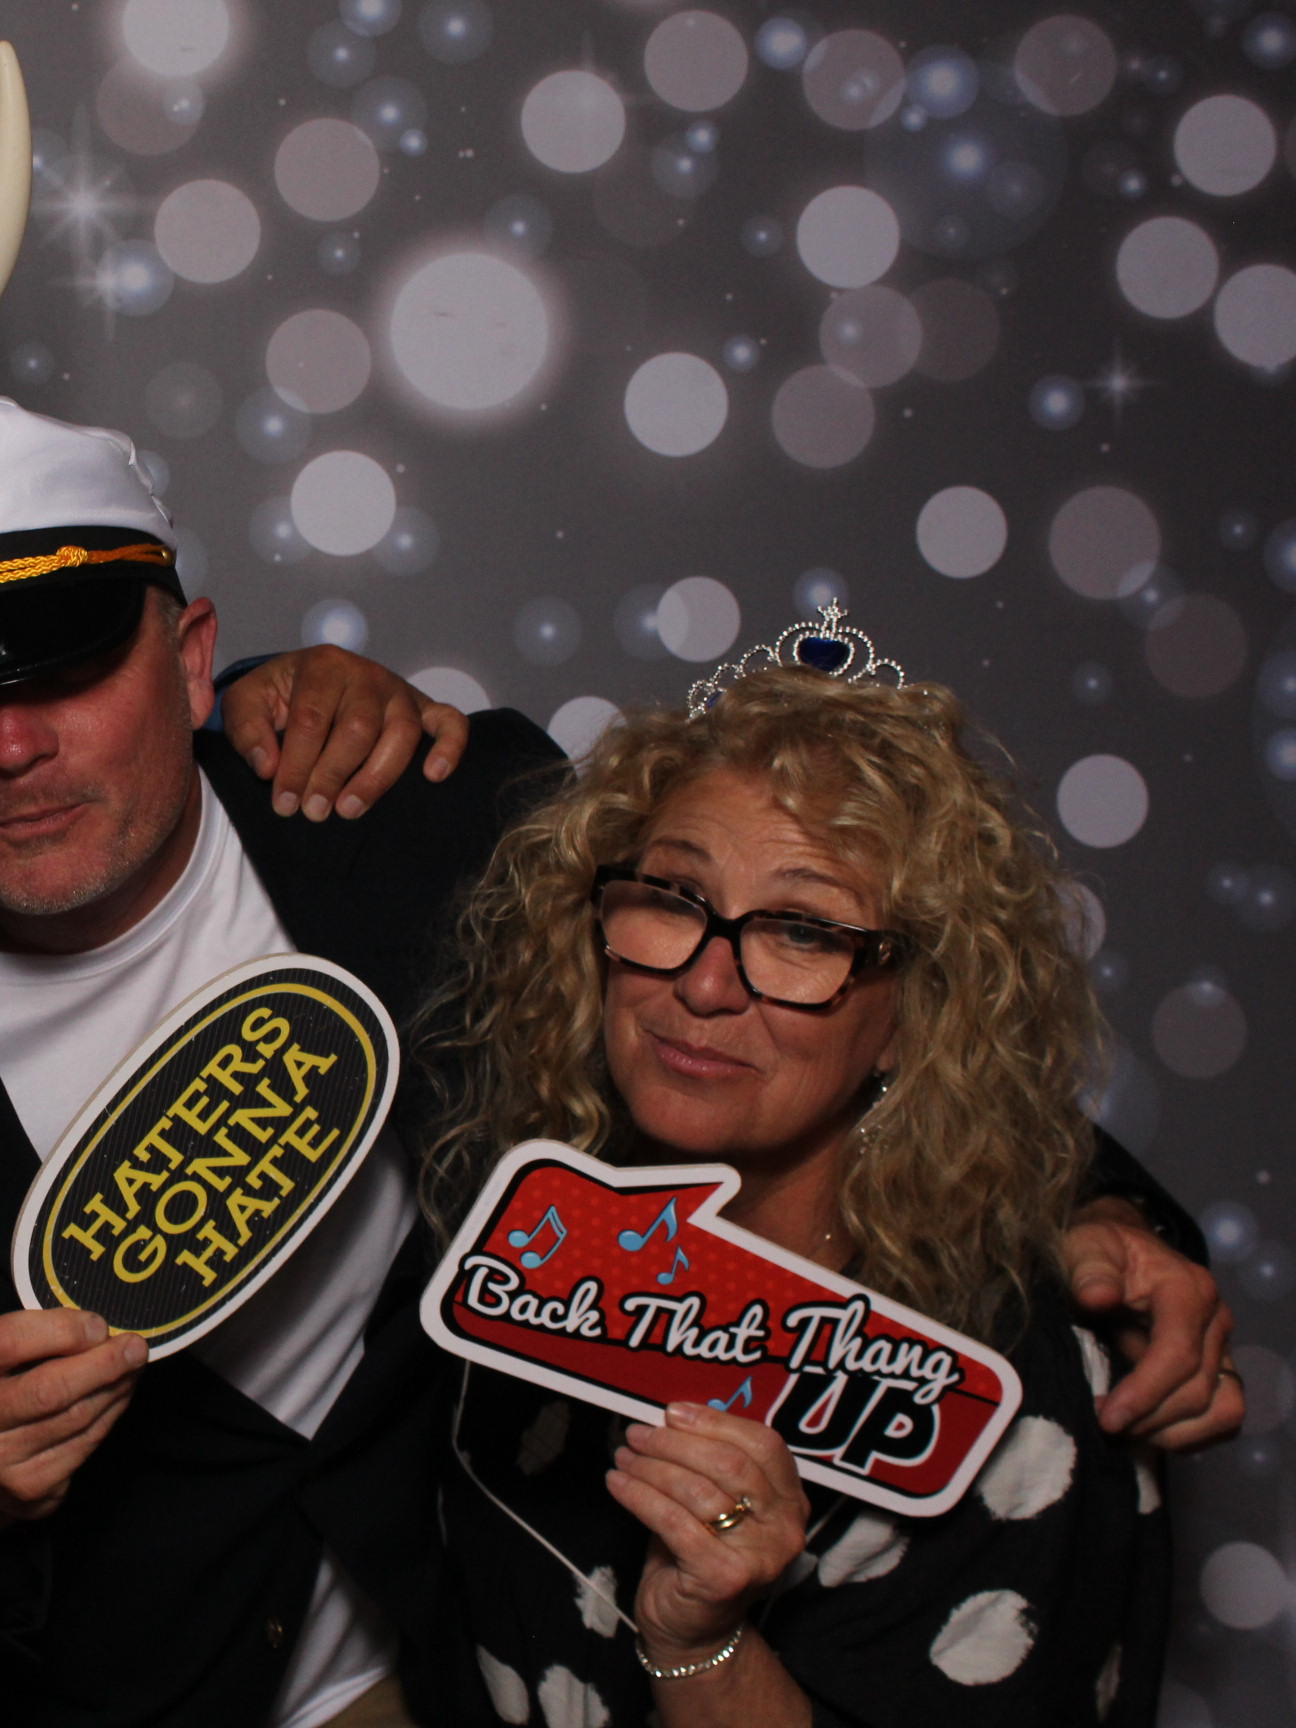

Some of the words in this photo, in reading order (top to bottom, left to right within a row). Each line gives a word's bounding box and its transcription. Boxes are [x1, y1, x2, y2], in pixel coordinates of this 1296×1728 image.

[62, 1007, 291, 1261] HATERS
[113, 1043, 338, 1283] GONNA
[175, 1106, 340, 1287] HATE
[463, 1254, 603, 1338] Back
[624, 1295, 766, 1363] That
[785, 1298, 960, 1404] Thang
[767, 1366, 939, 1476] UP
